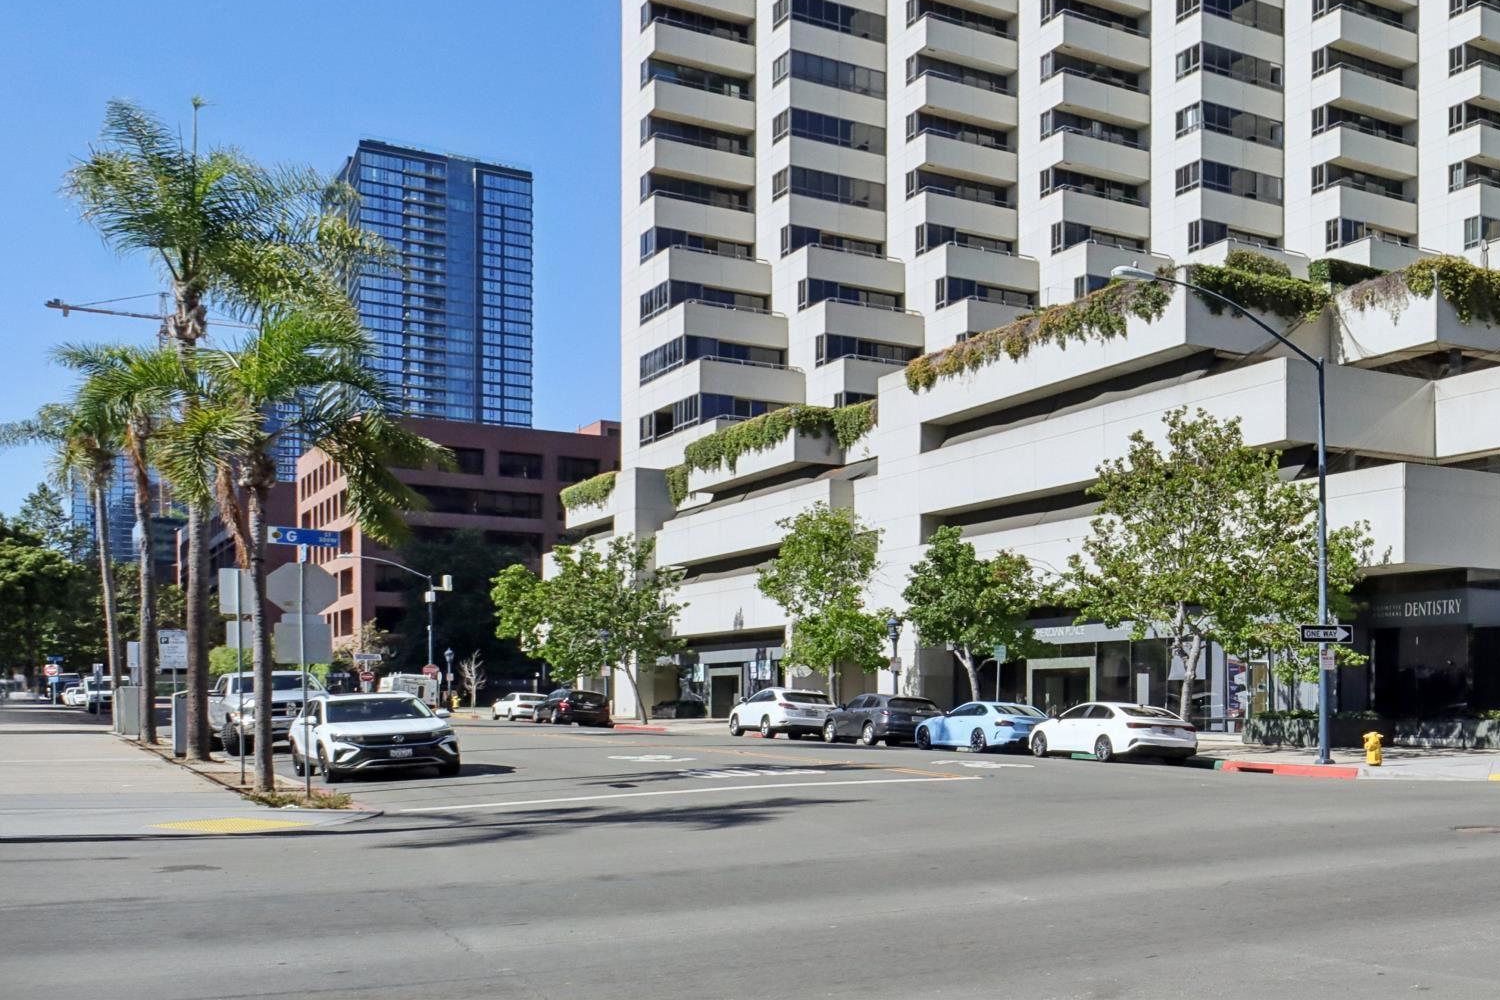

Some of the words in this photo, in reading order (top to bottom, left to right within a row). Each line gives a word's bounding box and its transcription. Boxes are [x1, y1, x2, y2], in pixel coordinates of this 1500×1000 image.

[286, 530, 298, 542] G
[1404, 599, 1462, 617] DENTISTRY
[1306, 630, 1321, 638] ONE
[1323, 630, 1338, 638] WAY
